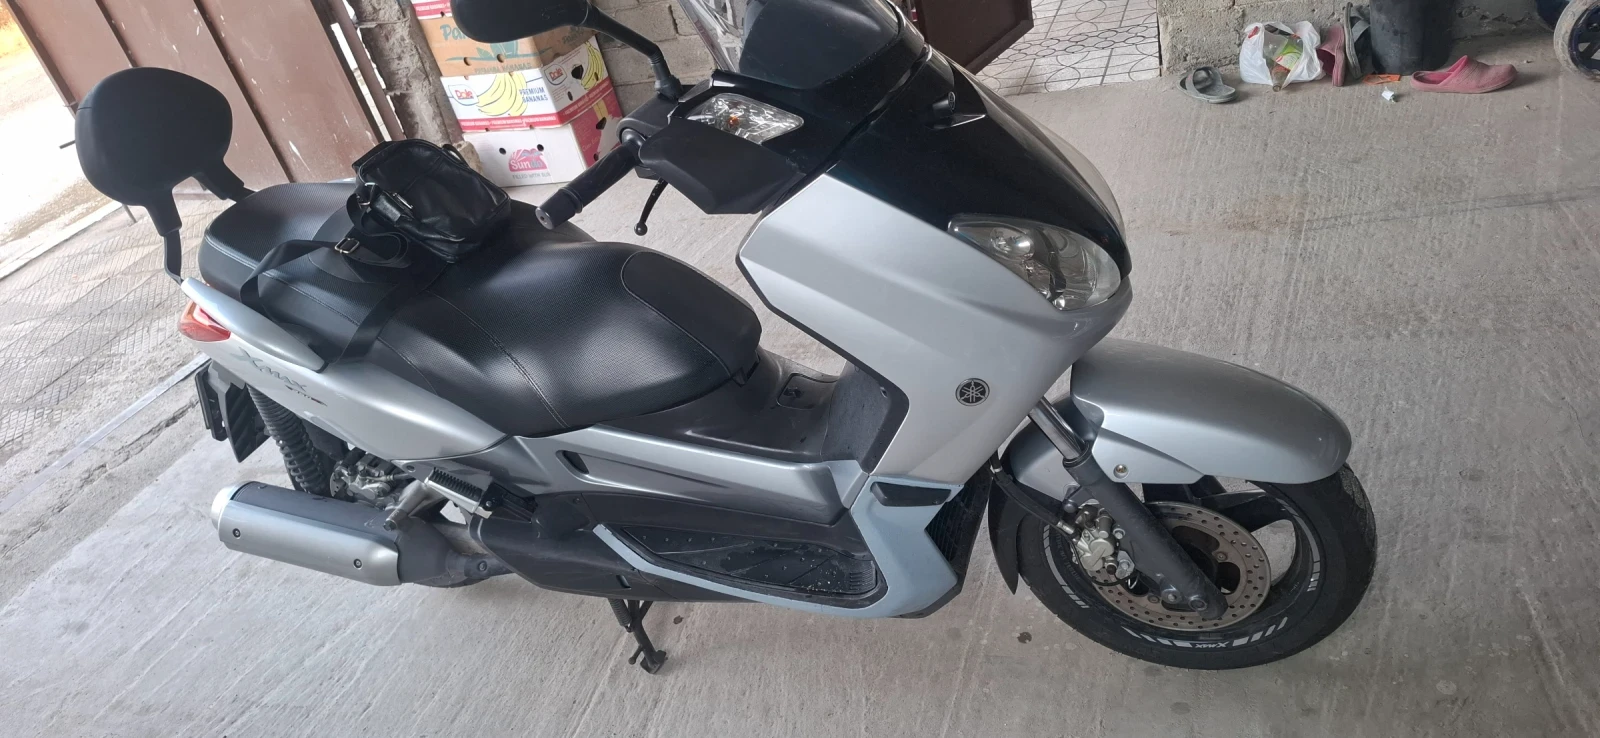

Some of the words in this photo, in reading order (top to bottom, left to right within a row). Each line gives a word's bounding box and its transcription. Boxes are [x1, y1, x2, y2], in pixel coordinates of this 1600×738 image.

[454, 88, 475, 100] Dole
[518, 86, 545, 95] PREMIUM
[521, 94, 549, 103] BANANAS
